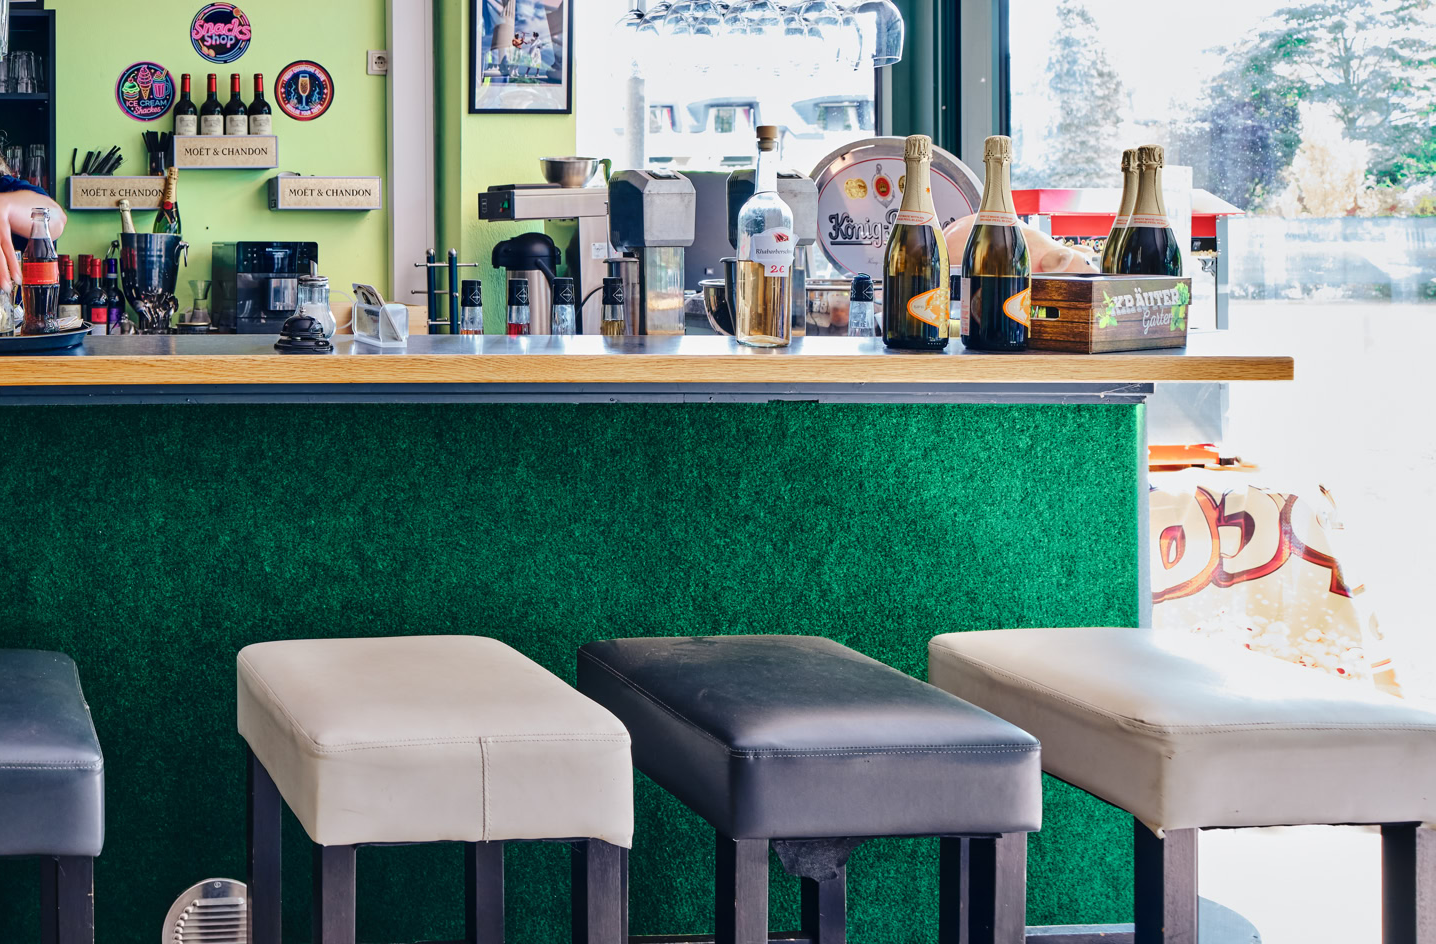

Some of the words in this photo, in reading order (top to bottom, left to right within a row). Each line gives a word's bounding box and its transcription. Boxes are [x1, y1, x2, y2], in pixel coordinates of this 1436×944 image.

[192, 18, 251, 40] Snacks
[204, 33, 235, 48] Shop
[184, 147, 211, 156] MOËT
[212, 148, 220, 156] &
[221, 147, 268, 156] CHANDON
[80, 188, 108, 197] MOËT
[109, 189, 117, 197] &
[118, 188, 165, 197] CHANDON
[288, 188, 316, 197] MOËT
[317, 189, 324, 197] &
[325, 188, 372, 197] CHANDON
[770, 264, 785, 273] 2€
[1111, 287, 1180, 311] KRÄUTER
